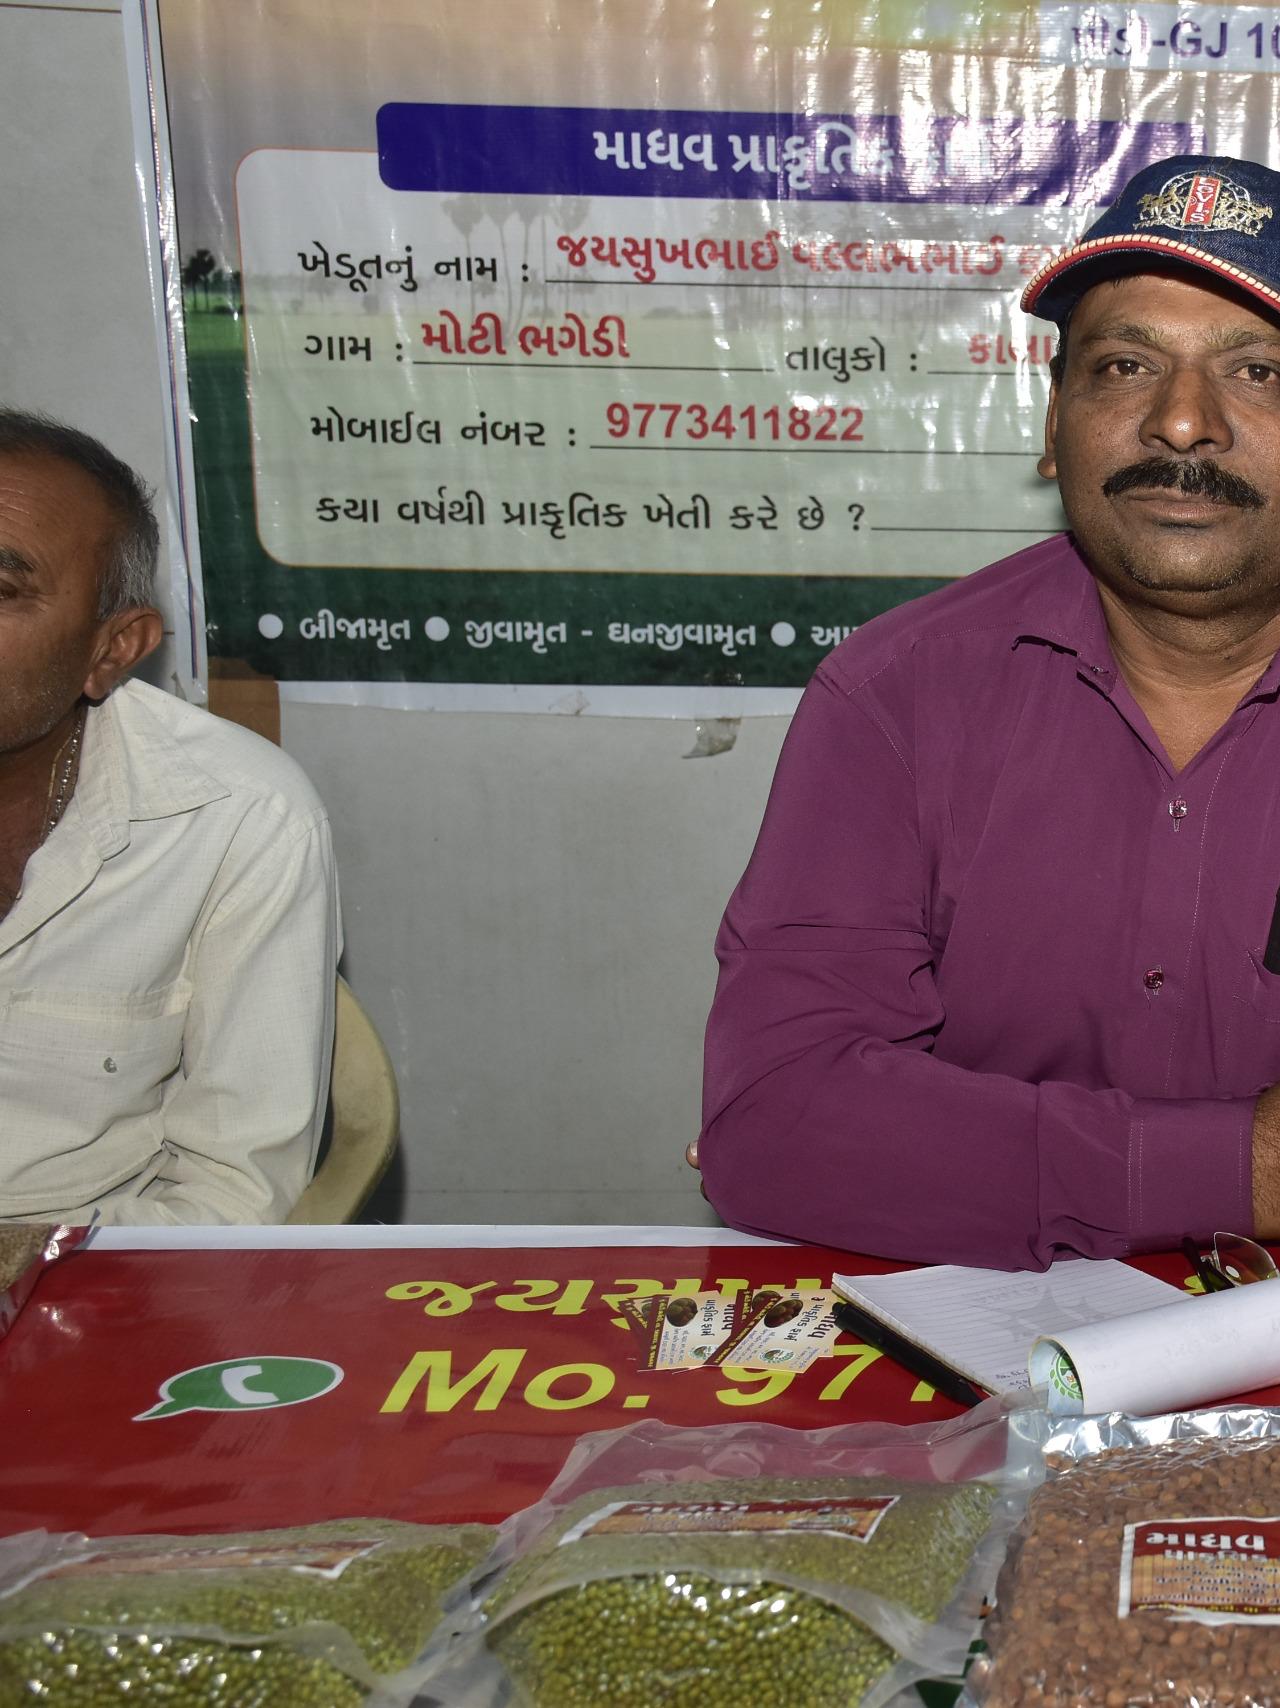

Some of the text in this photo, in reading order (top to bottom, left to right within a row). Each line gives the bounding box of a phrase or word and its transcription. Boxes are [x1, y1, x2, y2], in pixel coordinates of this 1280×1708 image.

[593, 128, 718, 172] માધવ
[298, 240, 418, 291] ખેડૂતનું
[434, 257, 498, 283] નામ
[556, 230, 780, 282] જયસુખભાઈ
[304, 334, 372, 361] ગામ
[421, 310, 506, 355] મોટી
[518, 314, 630, 358] ભગેડી
[786, 336, 886, 383] તાલુકો
[311, 406, 441, 445] મોબાઈલ
[460, 411, 546, 448] નંબર
[607, 402, 865, 442] 9773411822
[398, 485, 485, 527] વર્ષથી
[502, 493, 627, 540] પ્રાકૃતિક
[644, 493, 711, 529] ખેતી
[729, 496, 778, 530] કરે
[797, 496, 825, 531] છે
[300, 609, 411, 650] બીજામૃત
[465, 617, 566, 653] જીવામૃત
[608, 619, 756, 657] ઘનજીવામૃત
[379, 1349, 650, 1413] Mo.
[1147, 1532, 1265, 1551] માધવ
